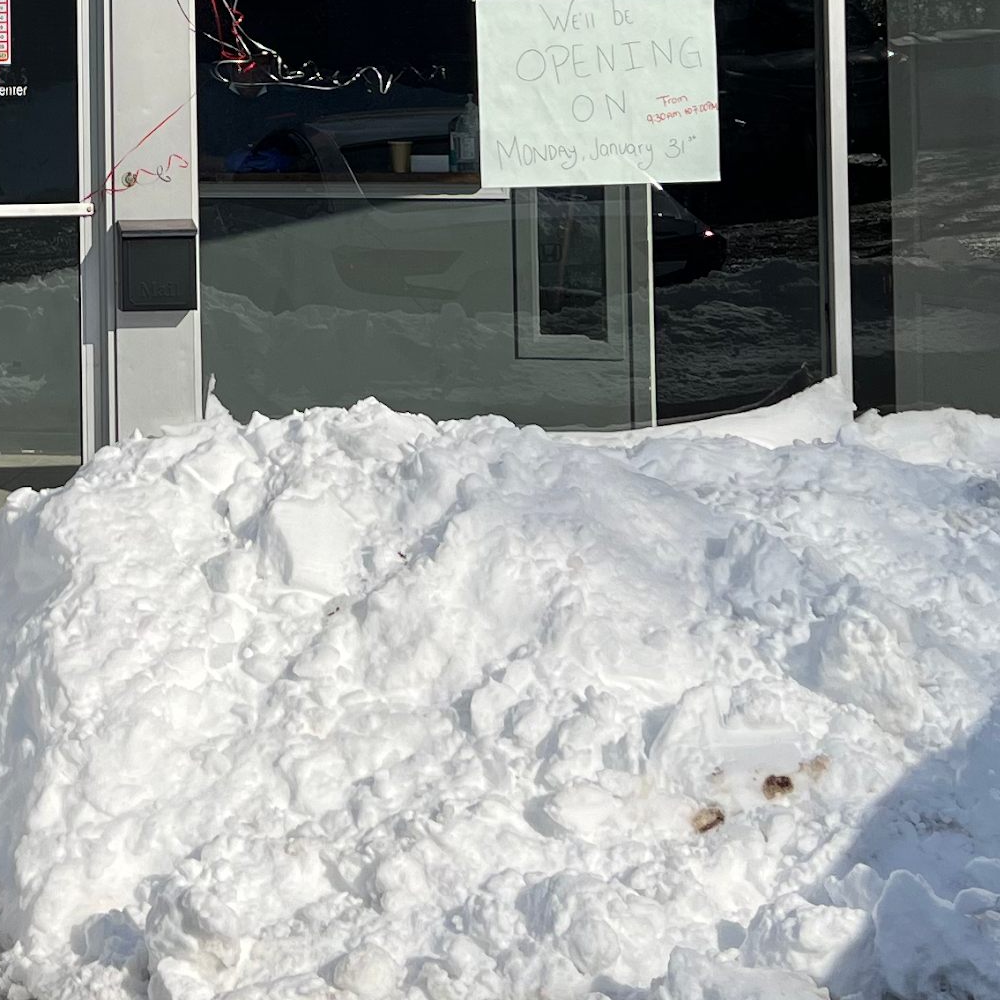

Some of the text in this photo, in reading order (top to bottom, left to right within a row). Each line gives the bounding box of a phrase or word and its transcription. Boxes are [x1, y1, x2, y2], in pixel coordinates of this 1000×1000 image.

[516, 36, 703, 84] OPENING
[572, 90, 627, 123] ON
[655, 94, 688, 108] From
[589, 136, 654, 171] January
[139, 281, 183, 298] Mail
